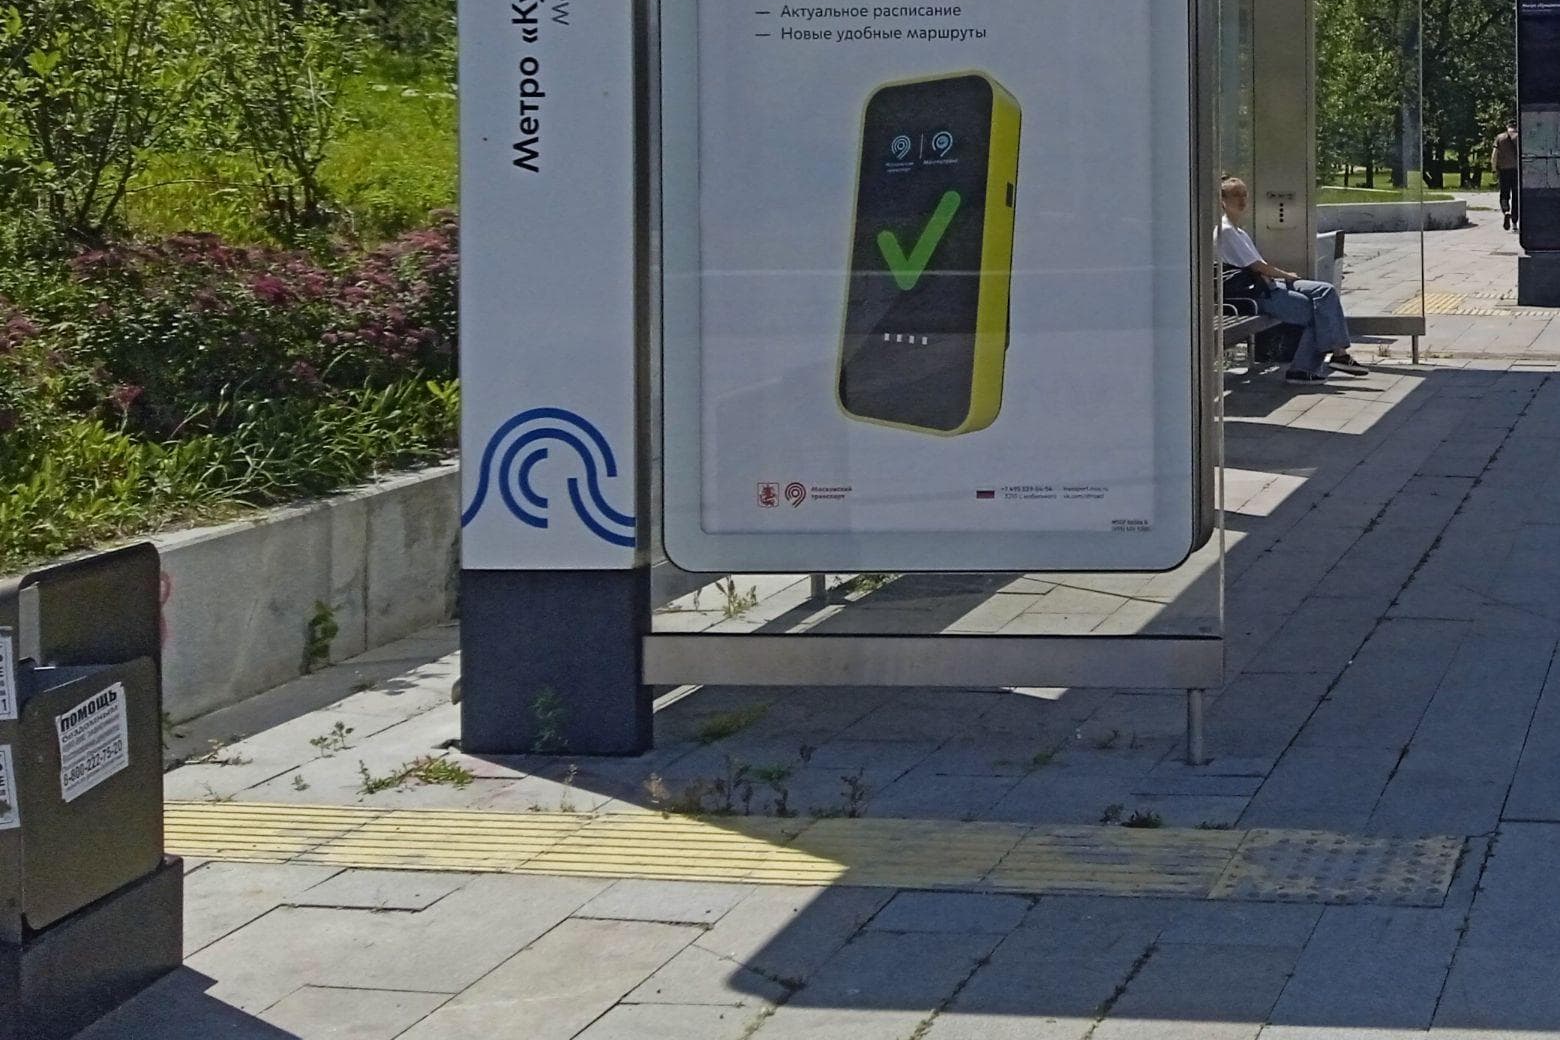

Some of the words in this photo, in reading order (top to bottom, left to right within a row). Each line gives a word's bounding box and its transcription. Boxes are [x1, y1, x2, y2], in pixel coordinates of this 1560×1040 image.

[780, 5, 869, 20] Актуальное
[873, 6, 962, 20] расписание
[781, 27, 833, 41] Новые
[836, 26, 903, 43] удобные
[907, 28, 987, 43] маршруты
[513, 57, 545, 173] Метро
[61, 688, 118, 733] ПОМОЩЬ
